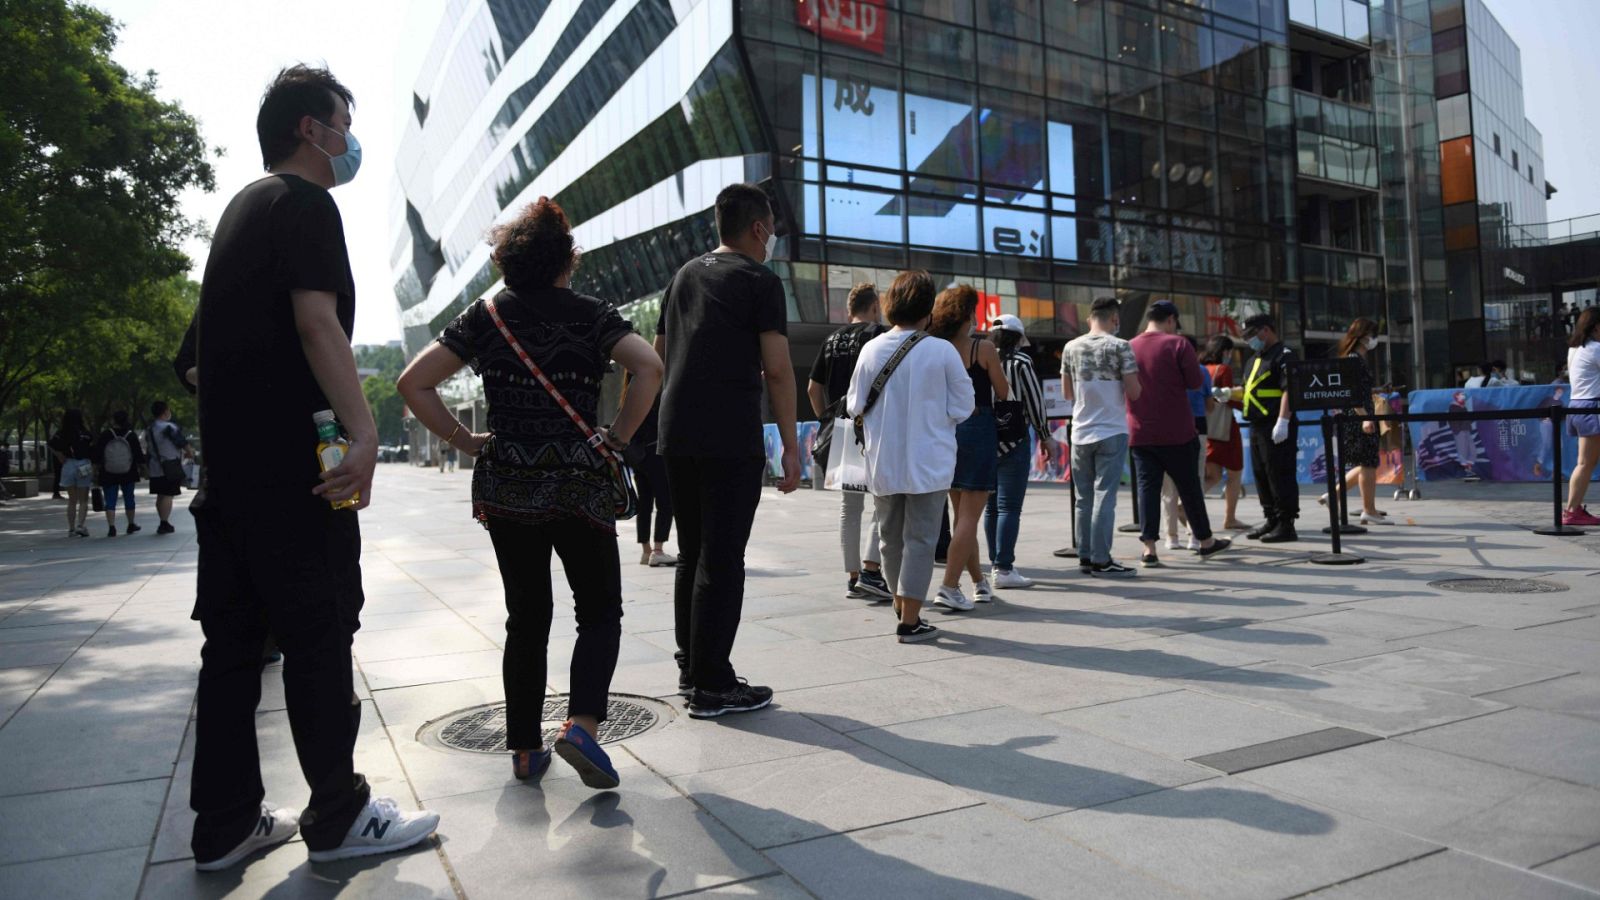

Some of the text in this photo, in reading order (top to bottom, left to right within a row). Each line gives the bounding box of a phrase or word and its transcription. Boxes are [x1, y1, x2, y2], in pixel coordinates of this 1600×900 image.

[1309, 374, 1341, 387] 入口
[1303, 390, 1351, 399] ENTRANCE
[256, 815, 275, 836] N
[361, 817, 391, 839] N
